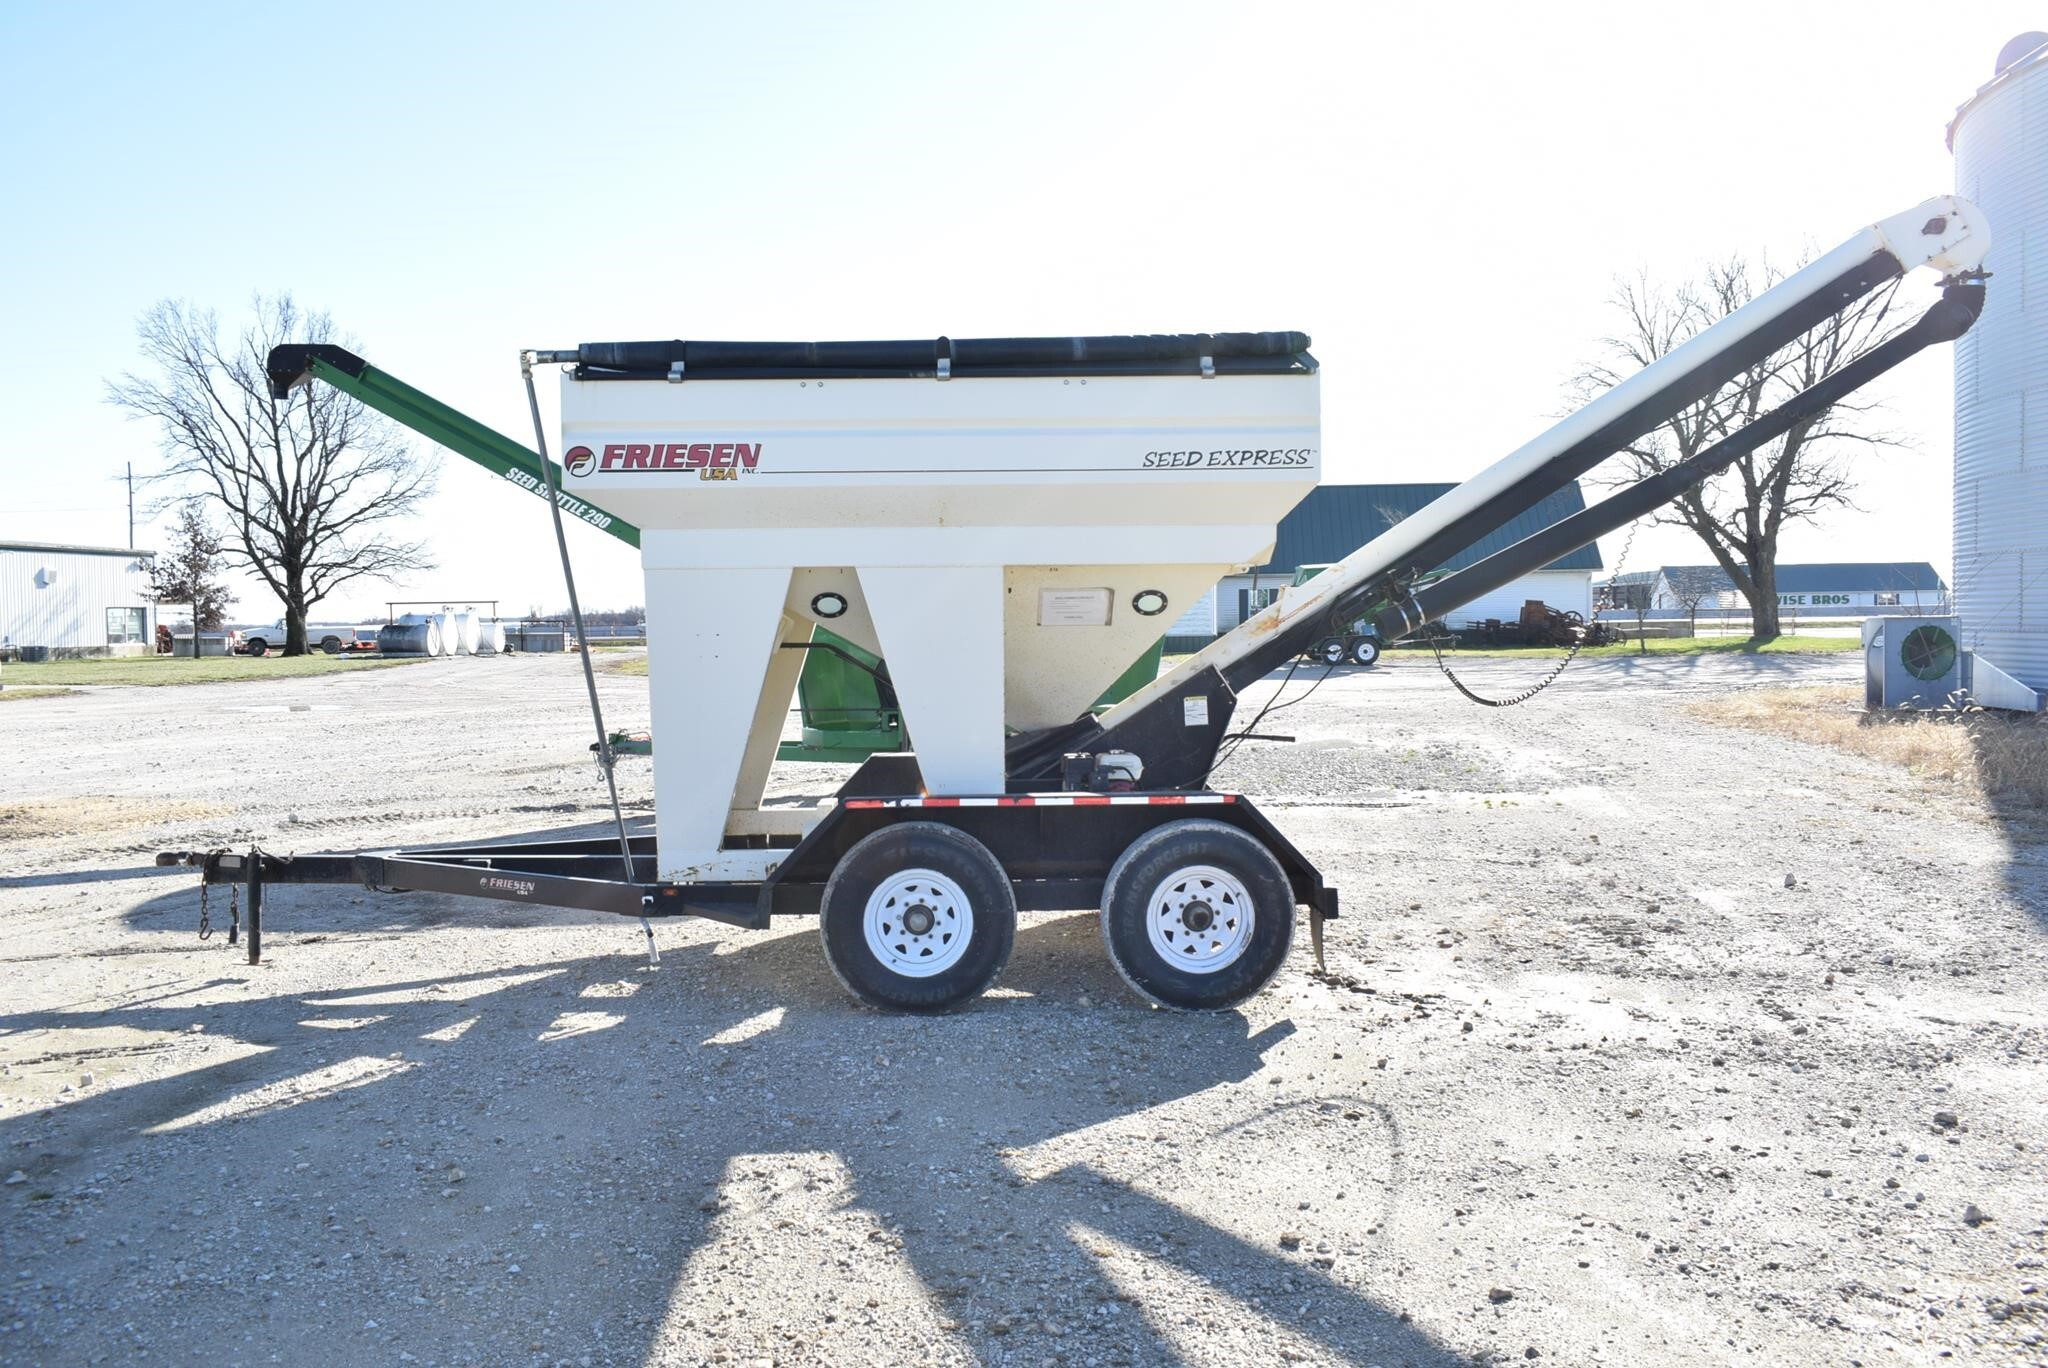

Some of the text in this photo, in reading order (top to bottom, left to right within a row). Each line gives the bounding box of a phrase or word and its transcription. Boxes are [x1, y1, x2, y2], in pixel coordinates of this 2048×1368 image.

[600, 443, 762, 469] FRIESEN
[1142, 448, 1311, 468] SEED EXPRESS
[700, 467, 738, 481] USA
[505, 466, 538, 490] SEED
[583, 509, 612, 530] 290
[1811, 594, 1850, 605] BROS
[489, 877, 535, 891] FRIESEN
